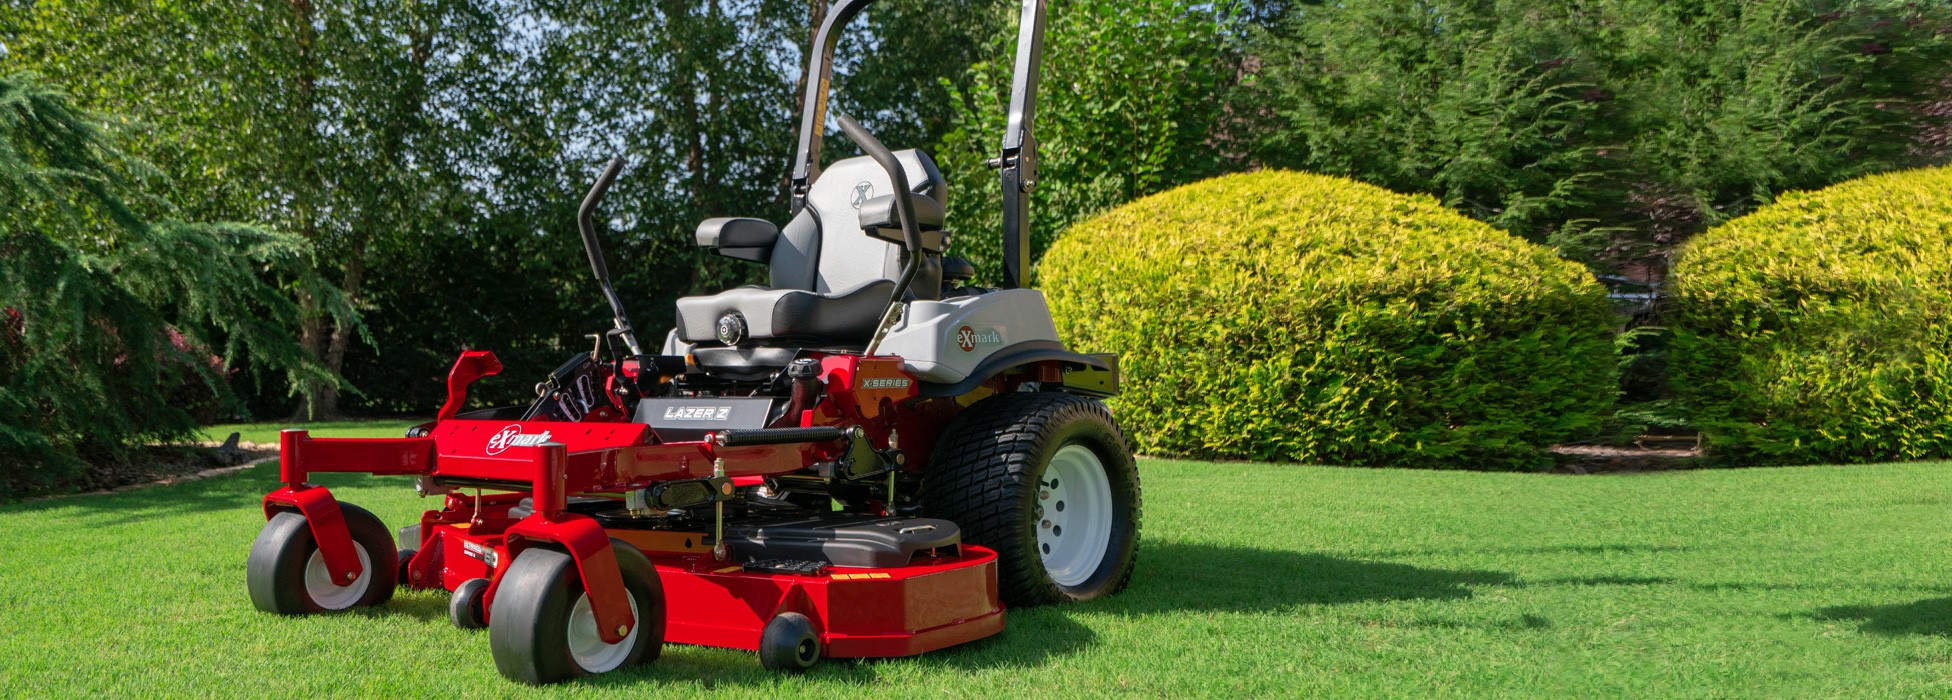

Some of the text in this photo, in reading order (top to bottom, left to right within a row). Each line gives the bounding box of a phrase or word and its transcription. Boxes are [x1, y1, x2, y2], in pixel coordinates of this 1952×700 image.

[957, 329, 1000, 348] eXmark
[664, 406, 732, 420] LAZER Z
